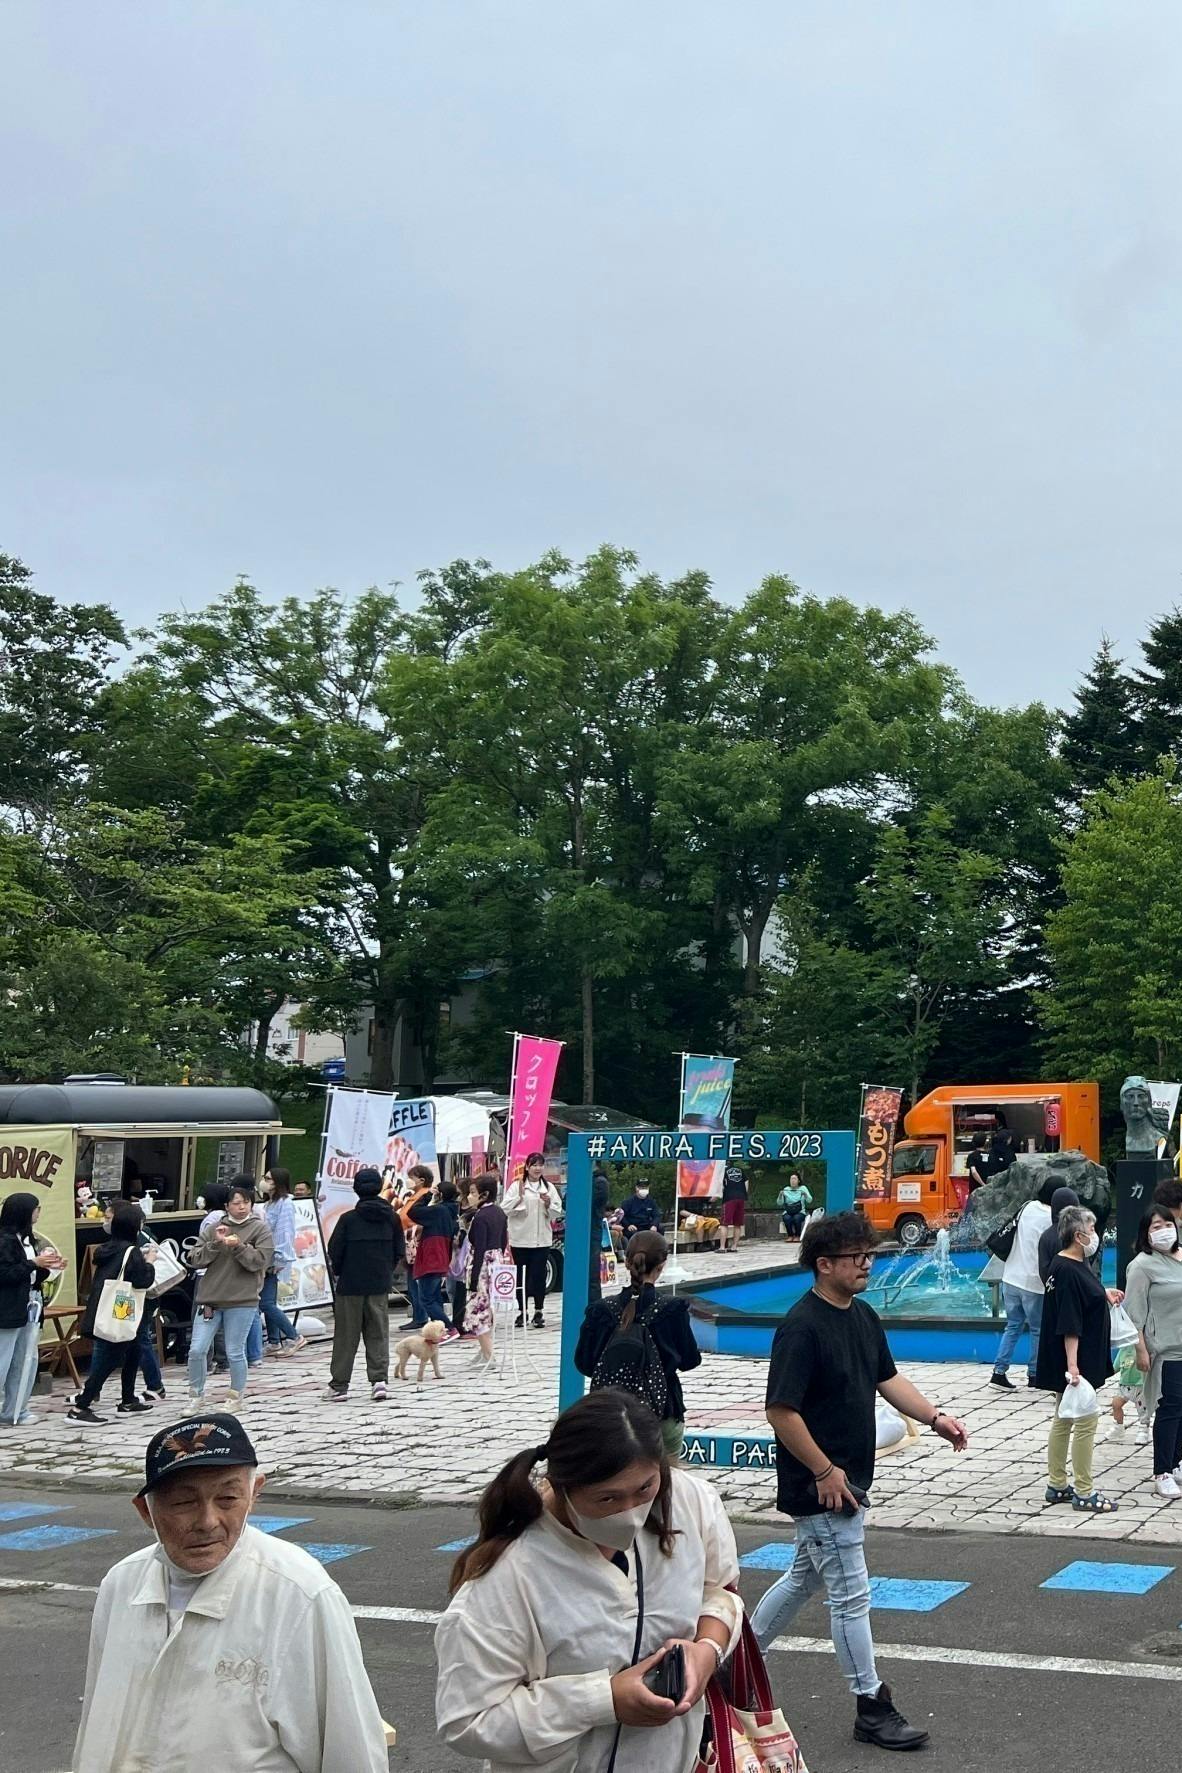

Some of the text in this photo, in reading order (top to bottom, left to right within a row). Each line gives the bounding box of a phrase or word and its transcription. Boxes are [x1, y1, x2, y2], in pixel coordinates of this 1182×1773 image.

[517, 1054, 542, 1142] クロッフル
[689, 1078, 733, 1105] juice
[389, 1102, 428, 1129] FFLE
[587, 1134, 822, 1158] #AKIRA FES. 2023
[862, 1119, 888, 1191] もつ煮
[0, 1145, 63, 1188] ORICE
